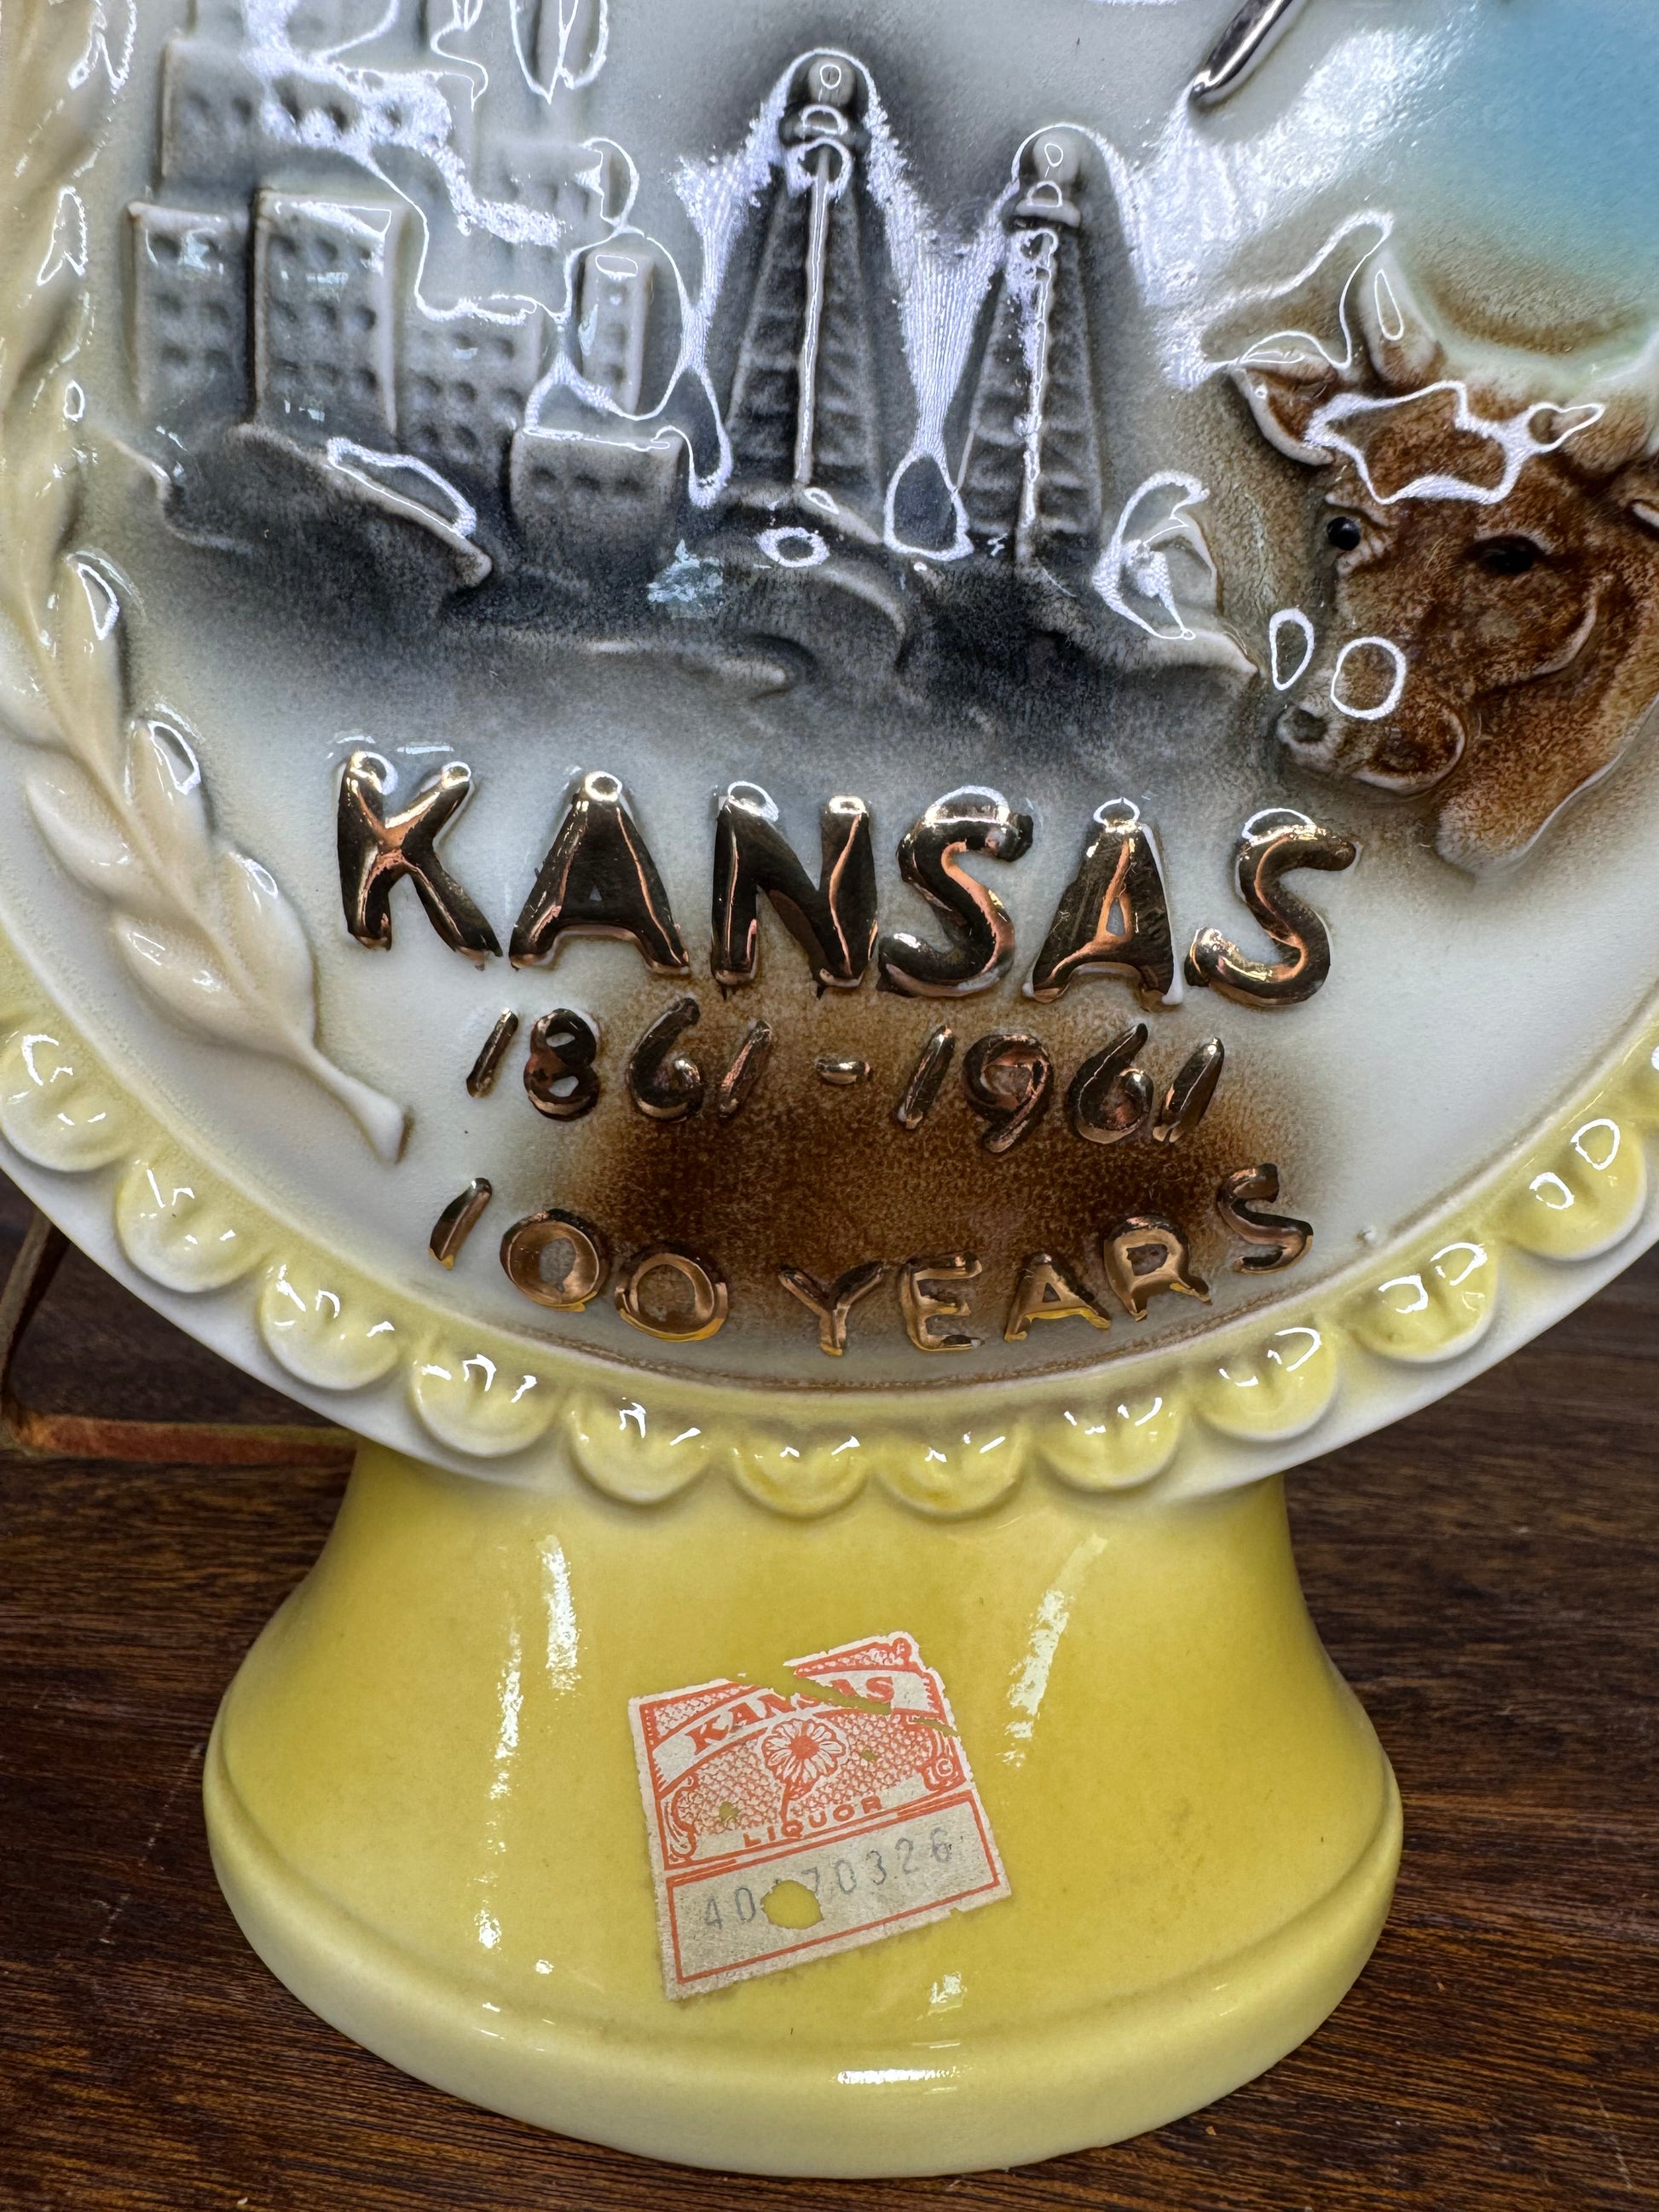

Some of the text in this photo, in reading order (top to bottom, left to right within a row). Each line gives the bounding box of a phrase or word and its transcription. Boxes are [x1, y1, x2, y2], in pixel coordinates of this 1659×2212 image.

[336, 749, 1358, 1011] KANSAS
[429, 1162, 1315, 1357] 100 YEARS
[743, 1795, 883, 1848] LIQUOR
